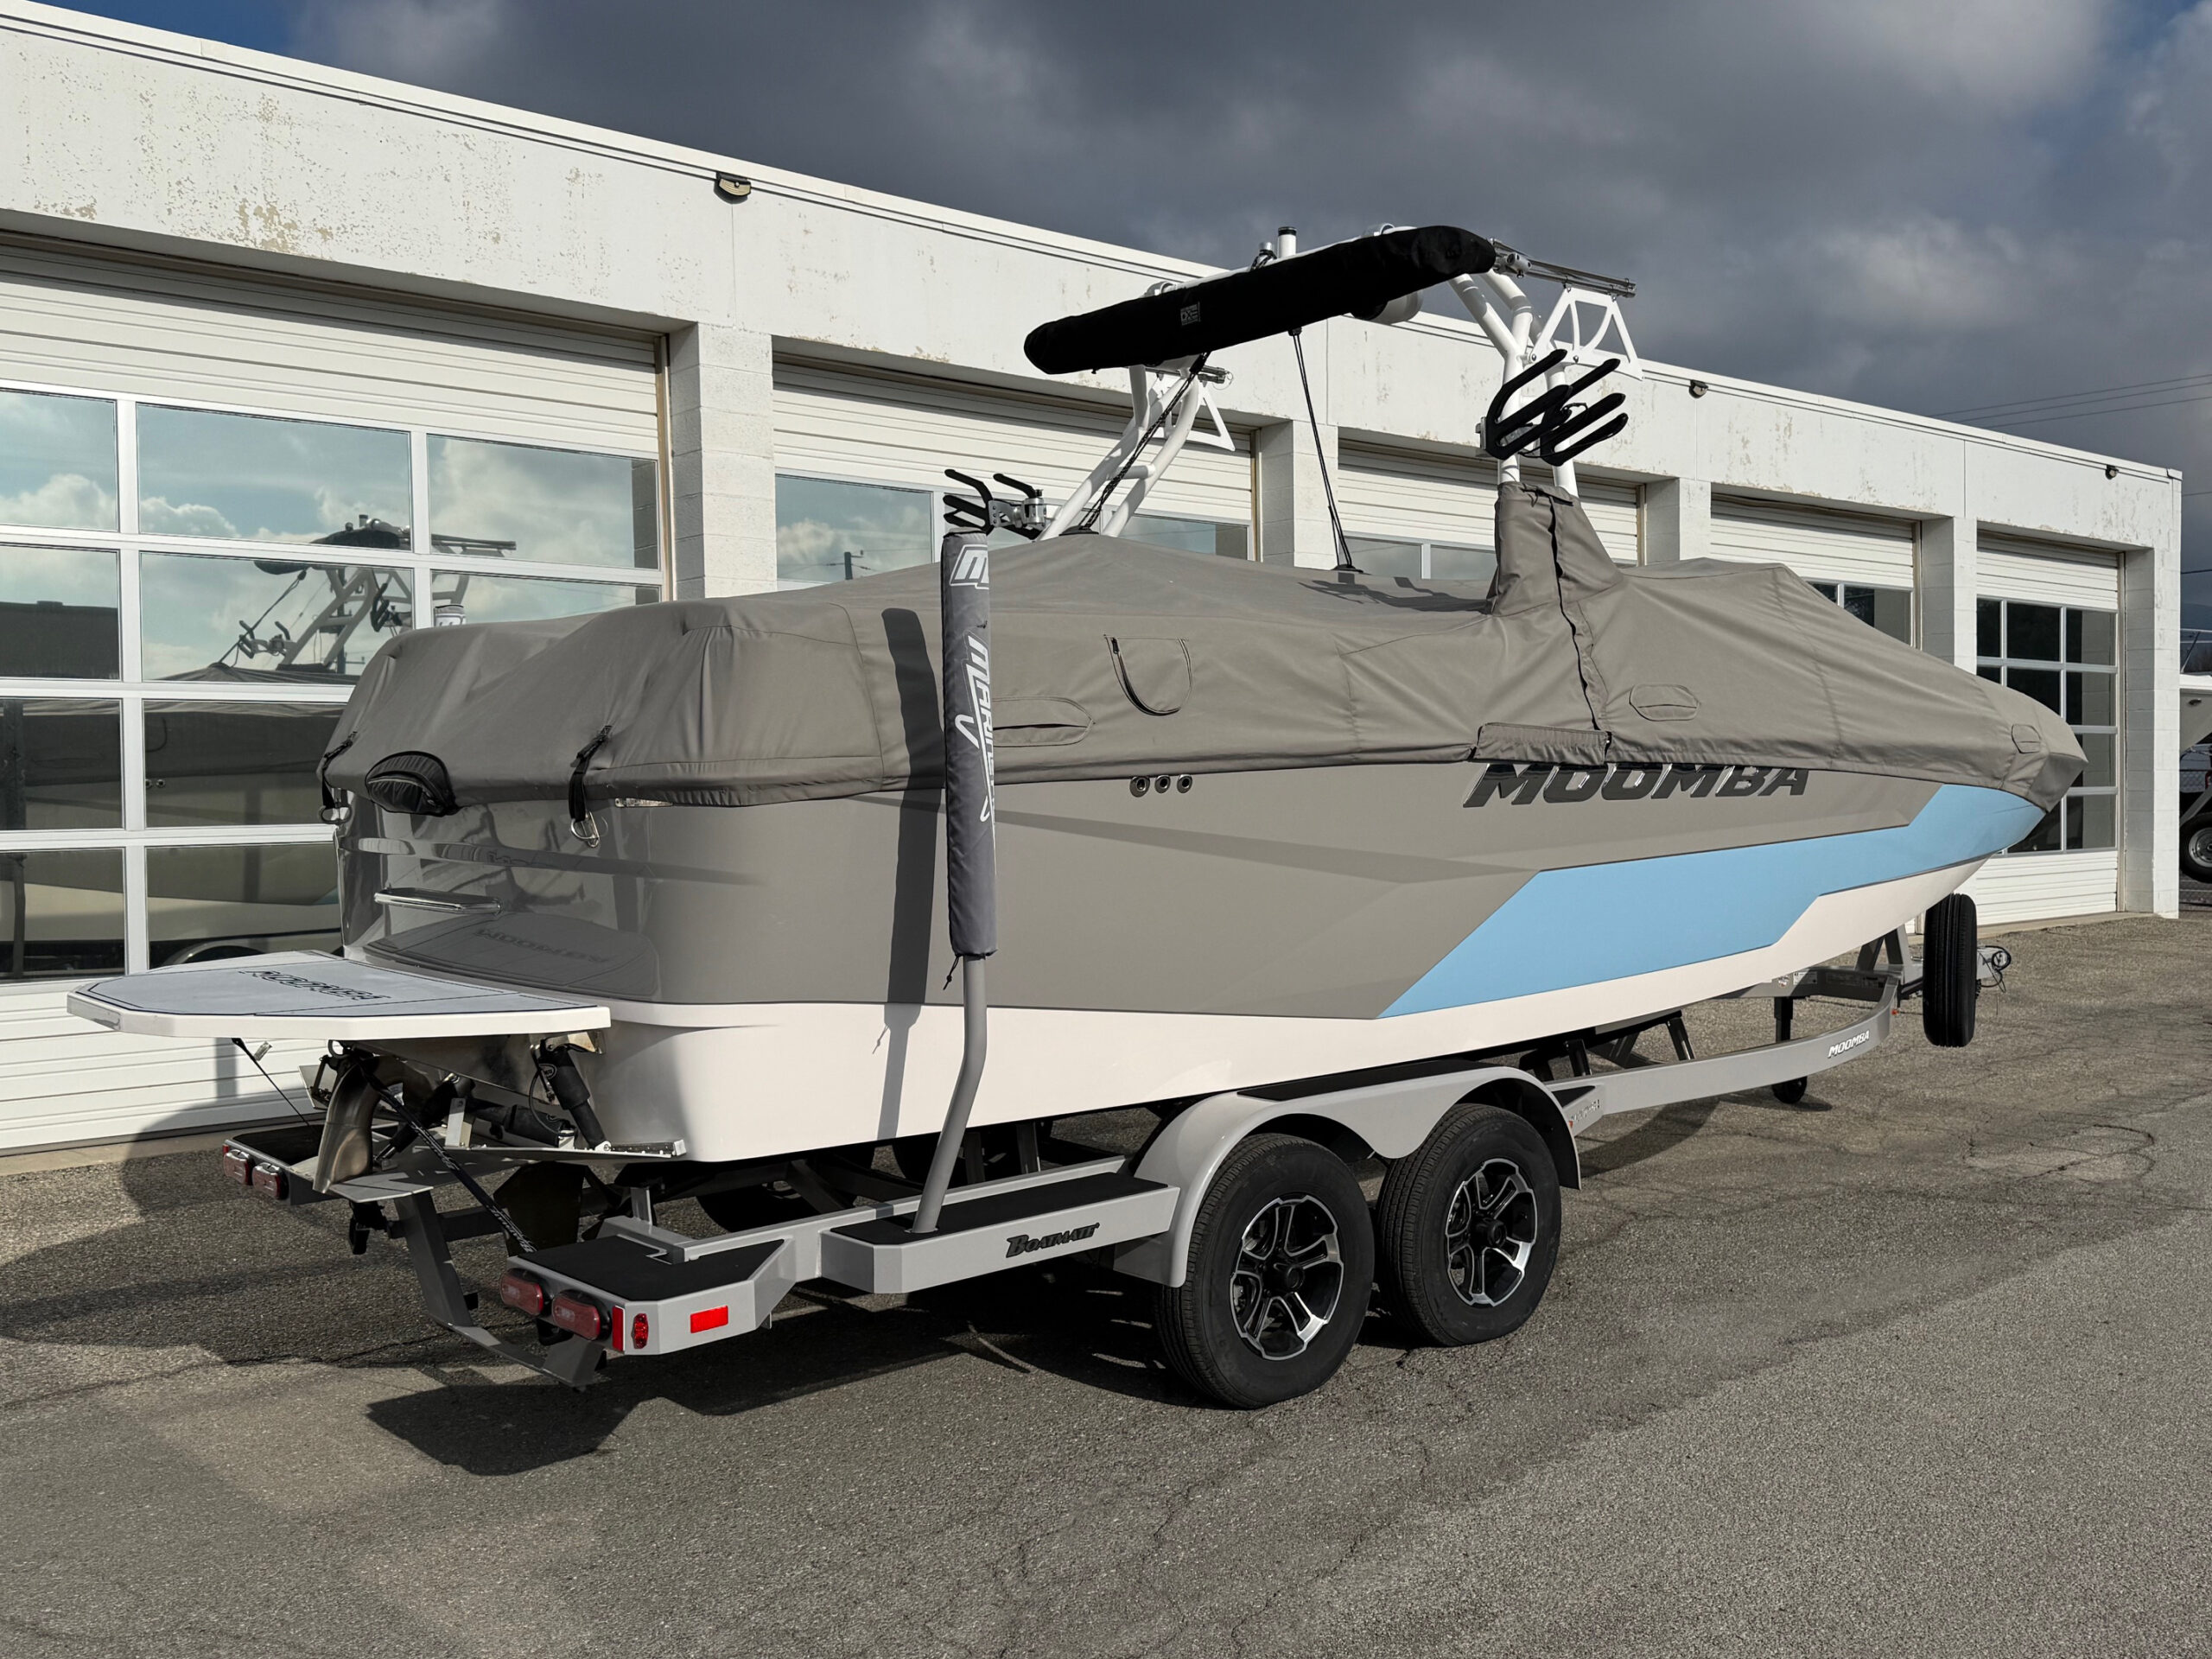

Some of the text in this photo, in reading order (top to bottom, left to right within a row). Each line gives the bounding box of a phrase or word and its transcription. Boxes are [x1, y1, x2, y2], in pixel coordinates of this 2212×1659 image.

[1463, 762, 1810, 808] MOOMBA
[1827, 1030, 1870, 1058] MOOMBA
[1006, 1223, 1100, 1258] BOATMATE
